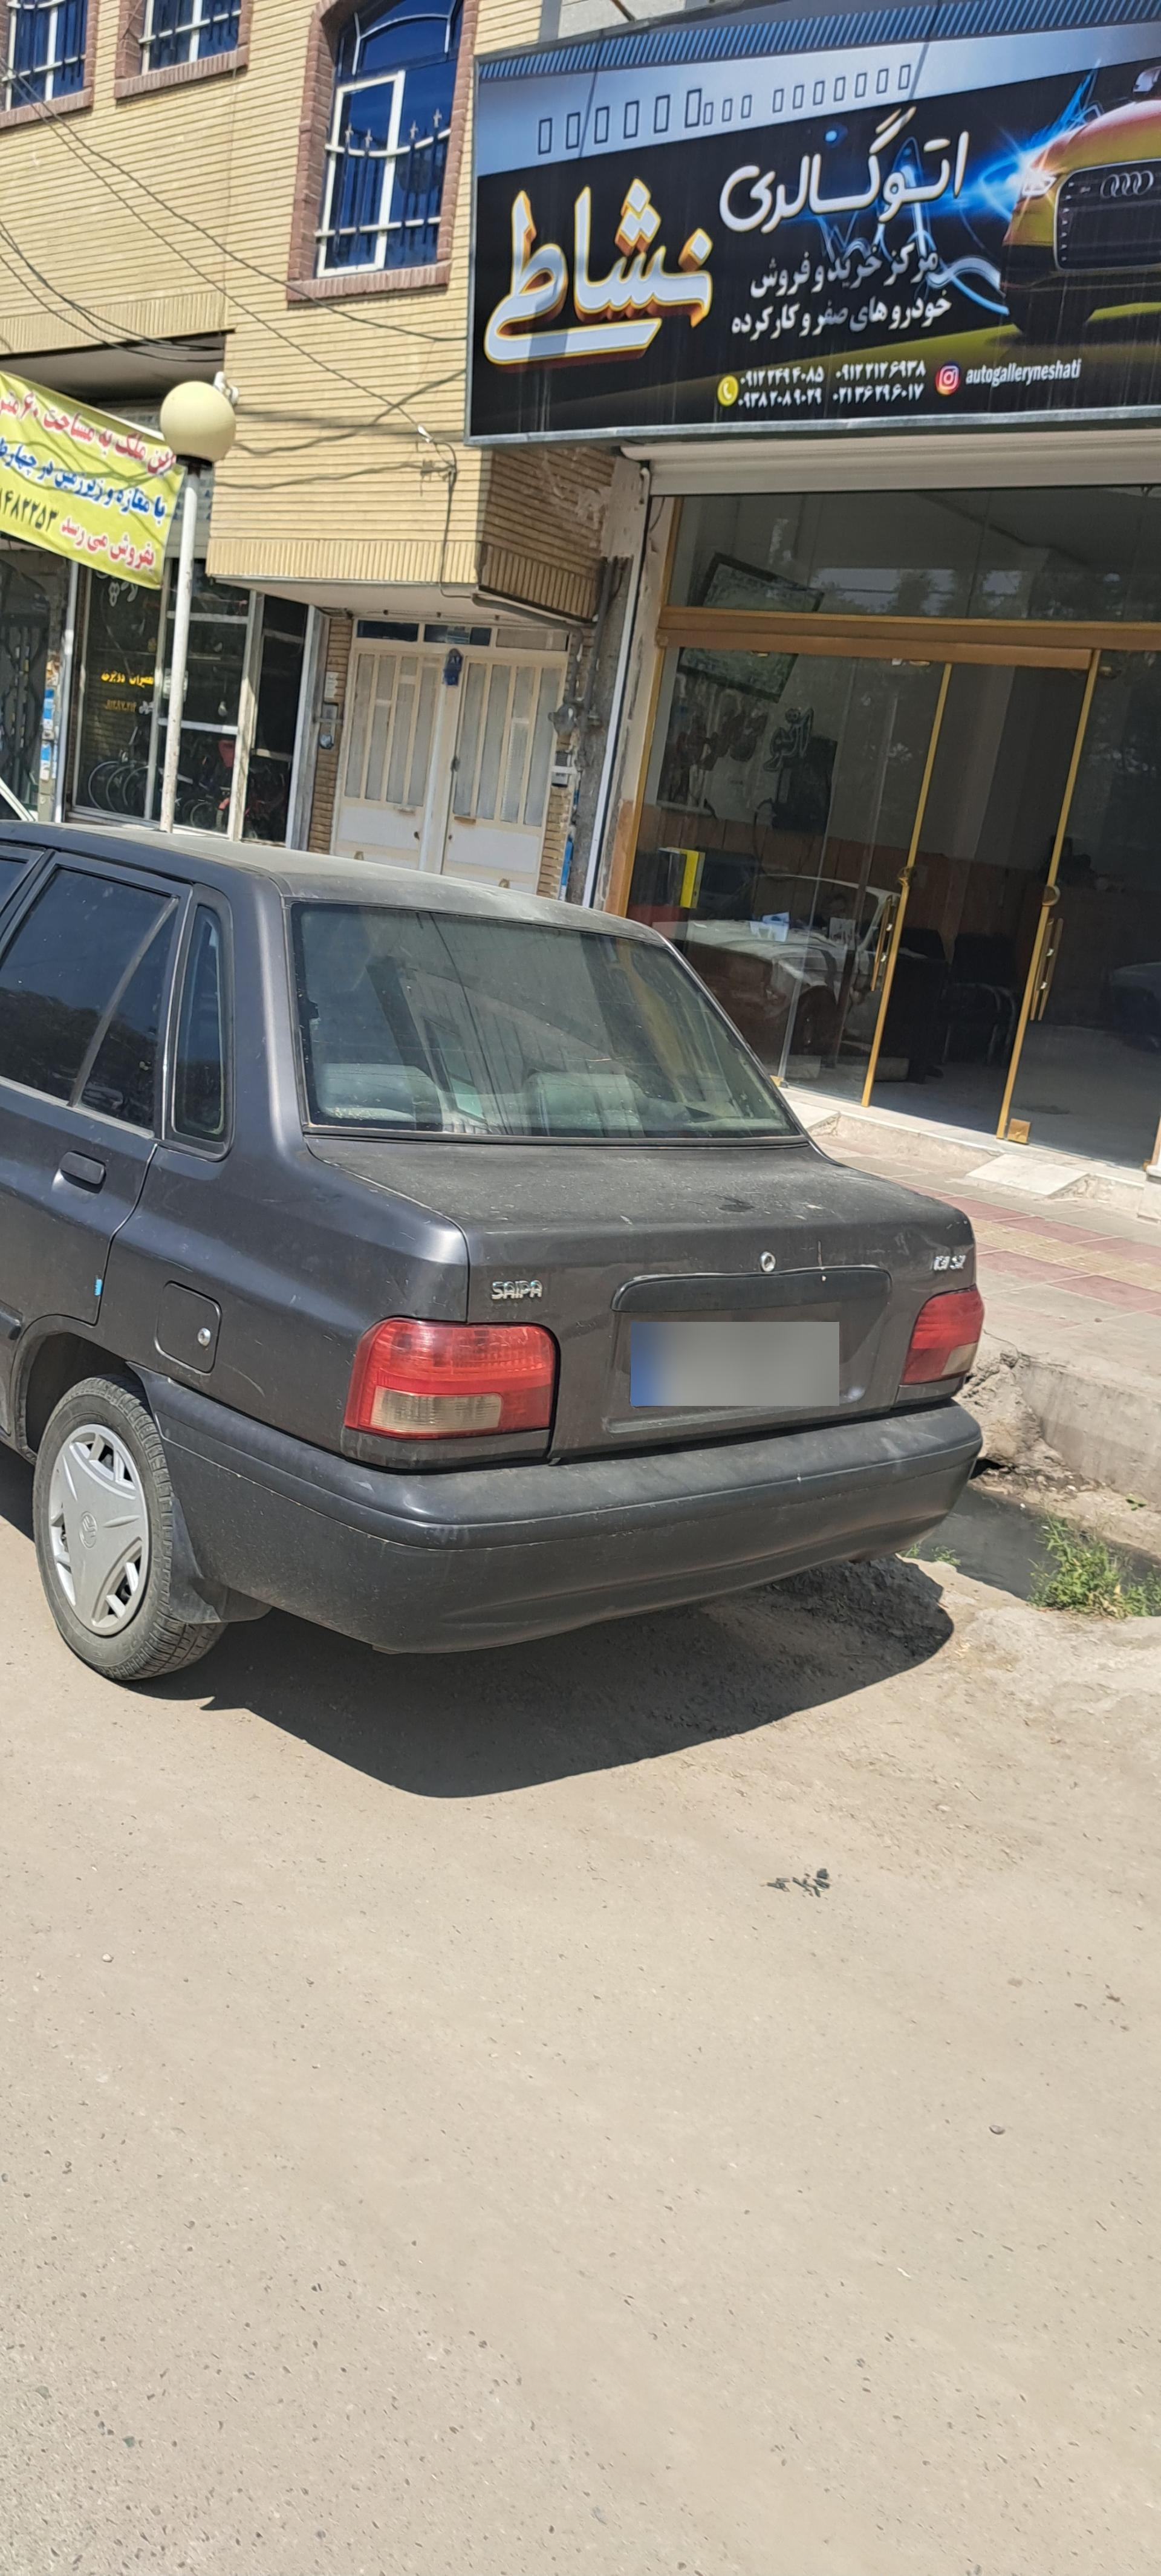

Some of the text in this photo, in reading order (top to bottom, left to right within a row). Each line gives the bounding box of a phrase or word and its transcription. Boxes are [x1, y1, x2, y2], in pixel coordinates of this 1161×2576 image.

[484, 177, 714, 366] نشاطی
[750, 242, 938, 298] مرکز خرید و فروش
[731, 302, 801, 341] کارکرده
[799, 312, 811, 337] و
[812, 300, 848, 336] صفر
[966, 358, 1082, 387] autogalleryneshati
[44, 410, 95, 441] مساحت
[99, 430, 112, 455] به
[115, 432, 146, 460] ملک
[37, 461, 53, 480] در
[104, 489, 114, 506] و
[116, 489, 149, 513] مغازه
[155, 496, 165, 524] با
[62, 518, 154, 571] بفروش می رسد
[492, 1280, 542, 1299] SAIPA
